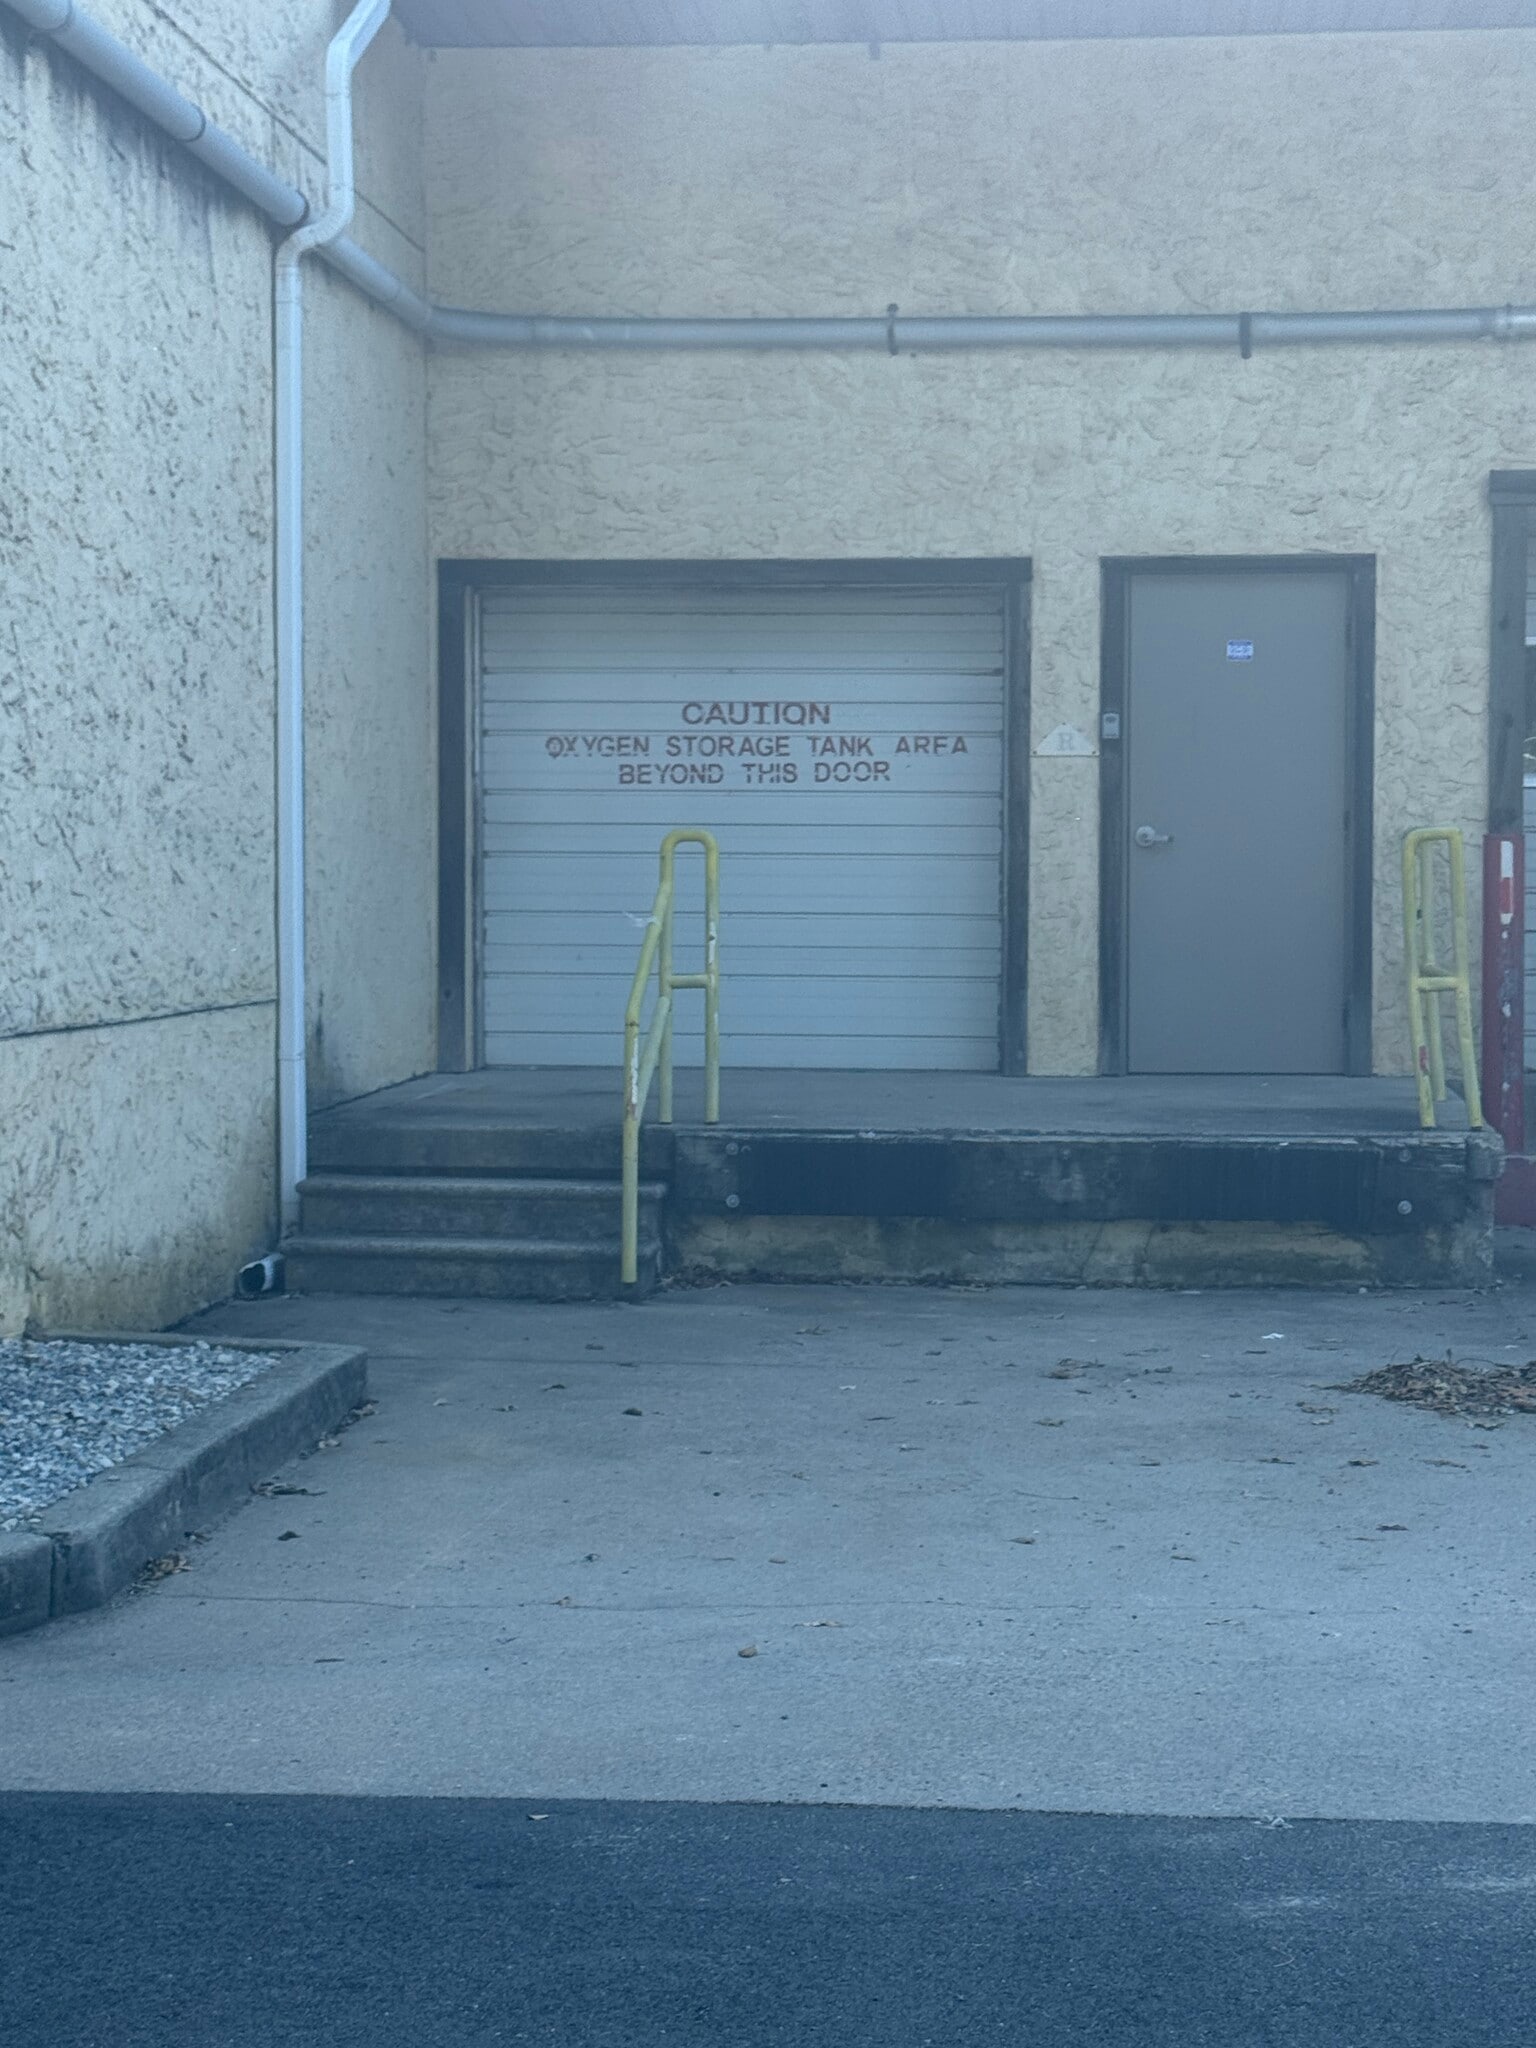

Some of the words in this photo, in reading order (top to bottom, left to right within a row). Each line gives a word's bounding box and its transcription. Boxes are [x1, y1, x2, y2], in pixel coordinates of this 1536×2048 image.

[682, 701, 831, 725] CAUTION
[545, 736, 650, 758] OXYGEN
[666, 736, 791, 757] STORAGE
[806, 736, 874, 757] TANK
[619, 763, 724, 784] BEYOND
[741, 763, 798, 784] THIS
[814, 761, 891, 783] DOOR
